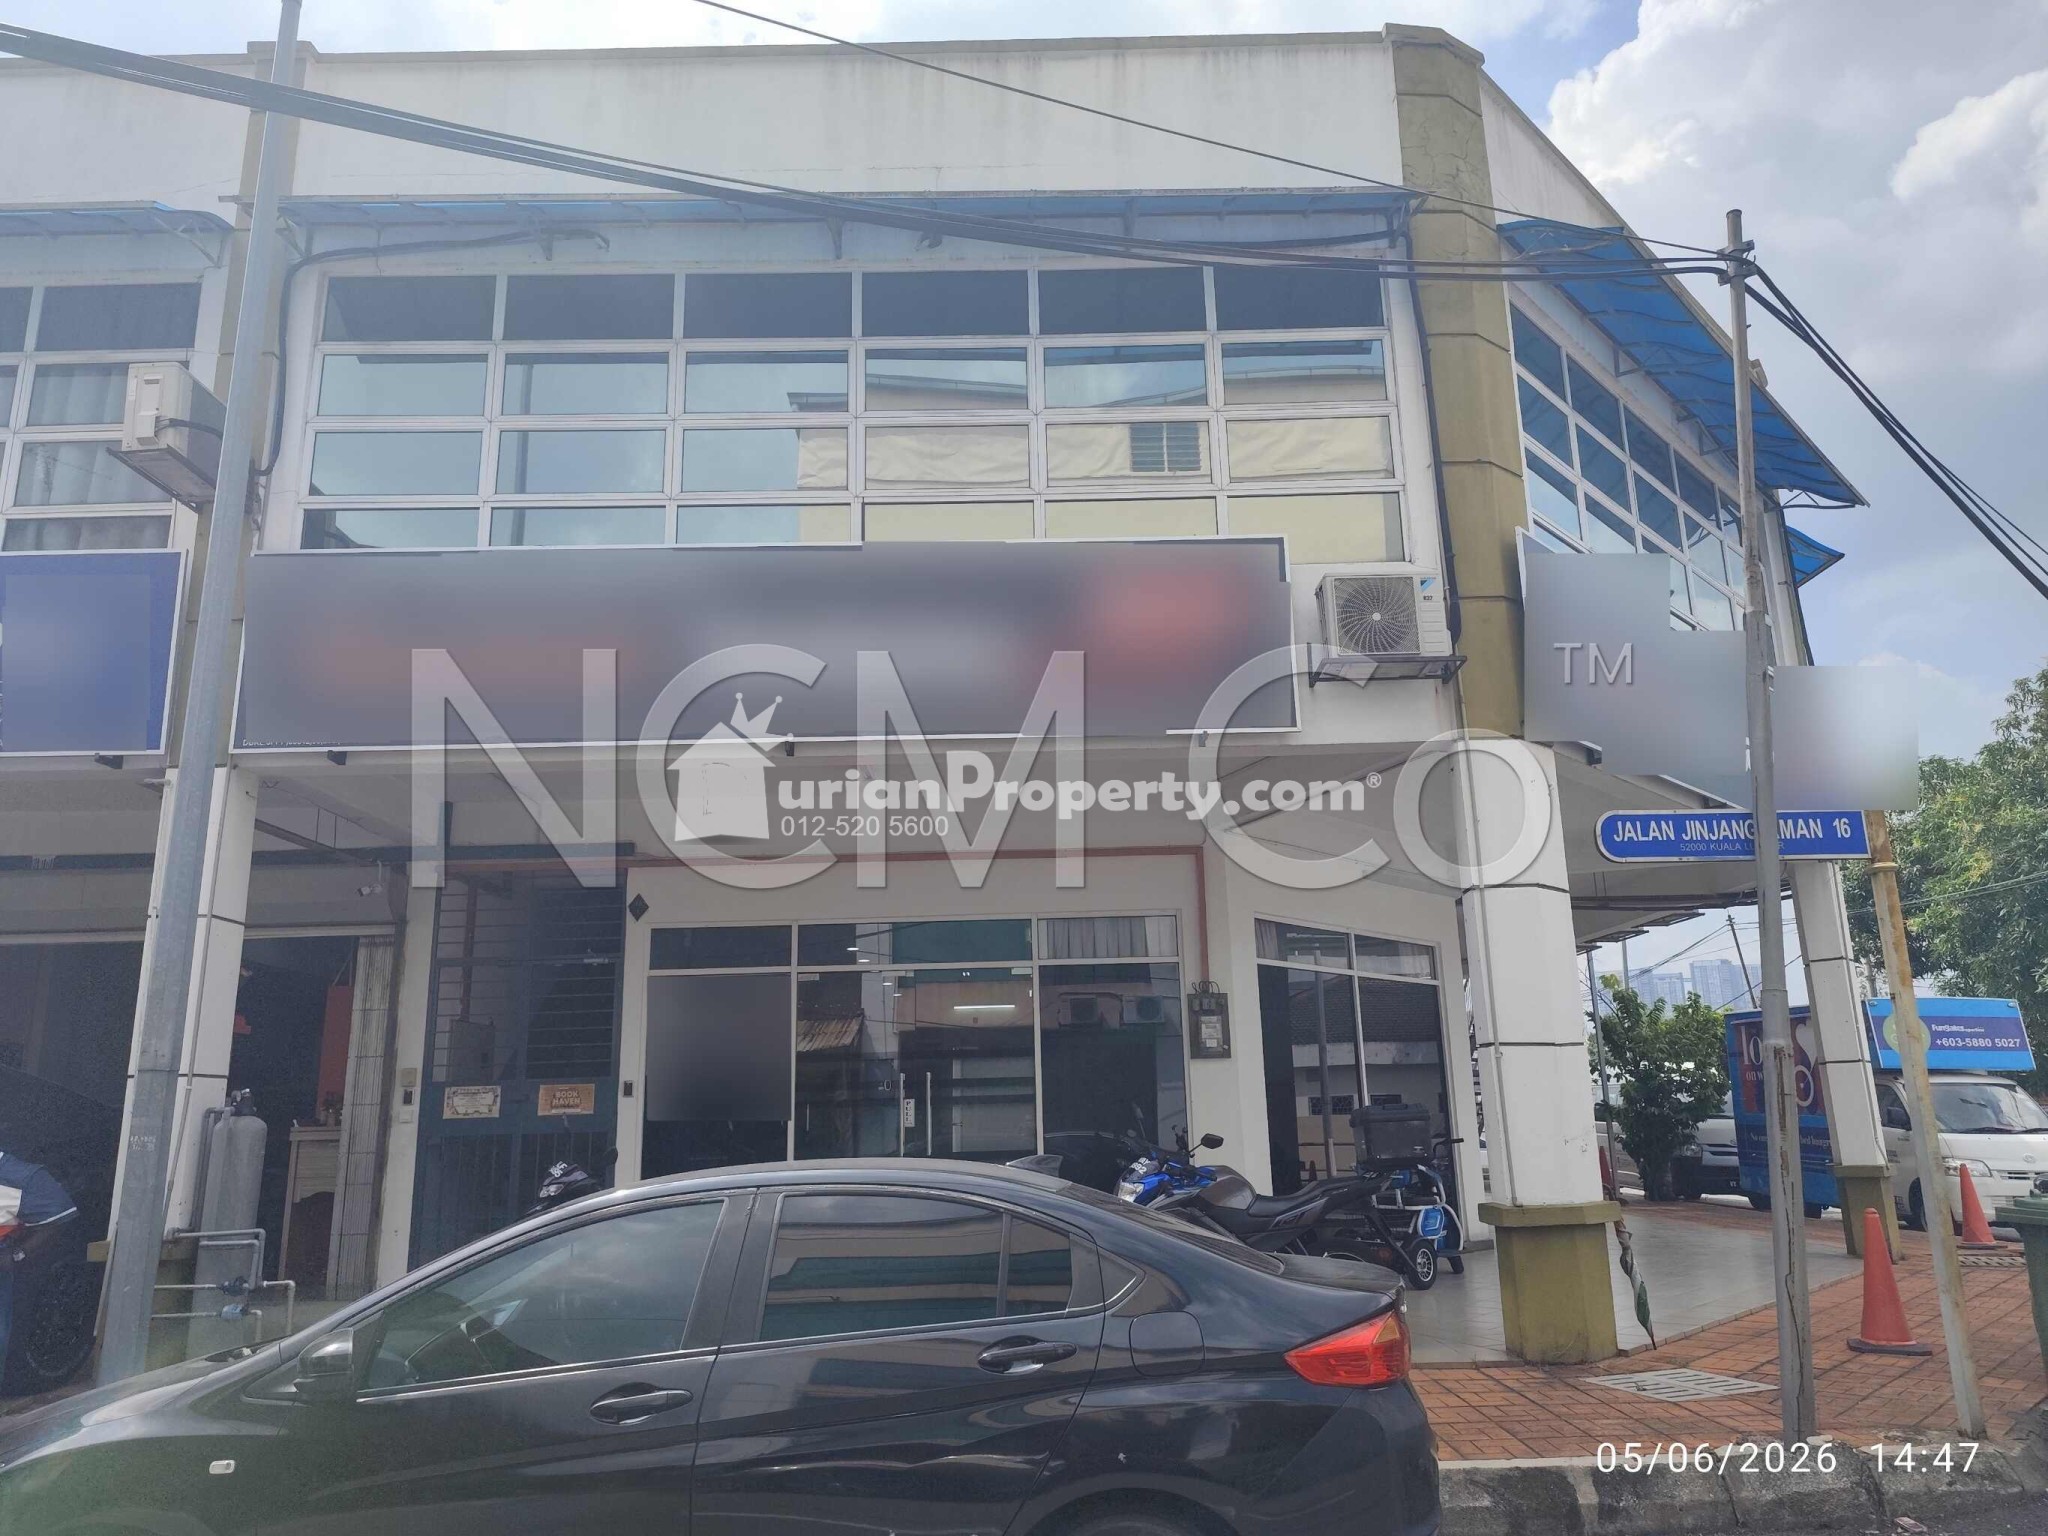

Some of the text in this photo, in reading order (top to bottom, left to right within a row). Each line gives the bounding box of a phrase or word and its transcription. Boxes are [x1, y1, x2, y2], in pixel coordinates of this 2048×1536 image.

[1613, 818, 1852, 842] JALAN JINJANG MAN 16
[1680, 843, 1707, 851] 52000
[1710, 842, 1742, 851] KUALA
[1936, 1037, 2020, 1047] +603-5880 5027
